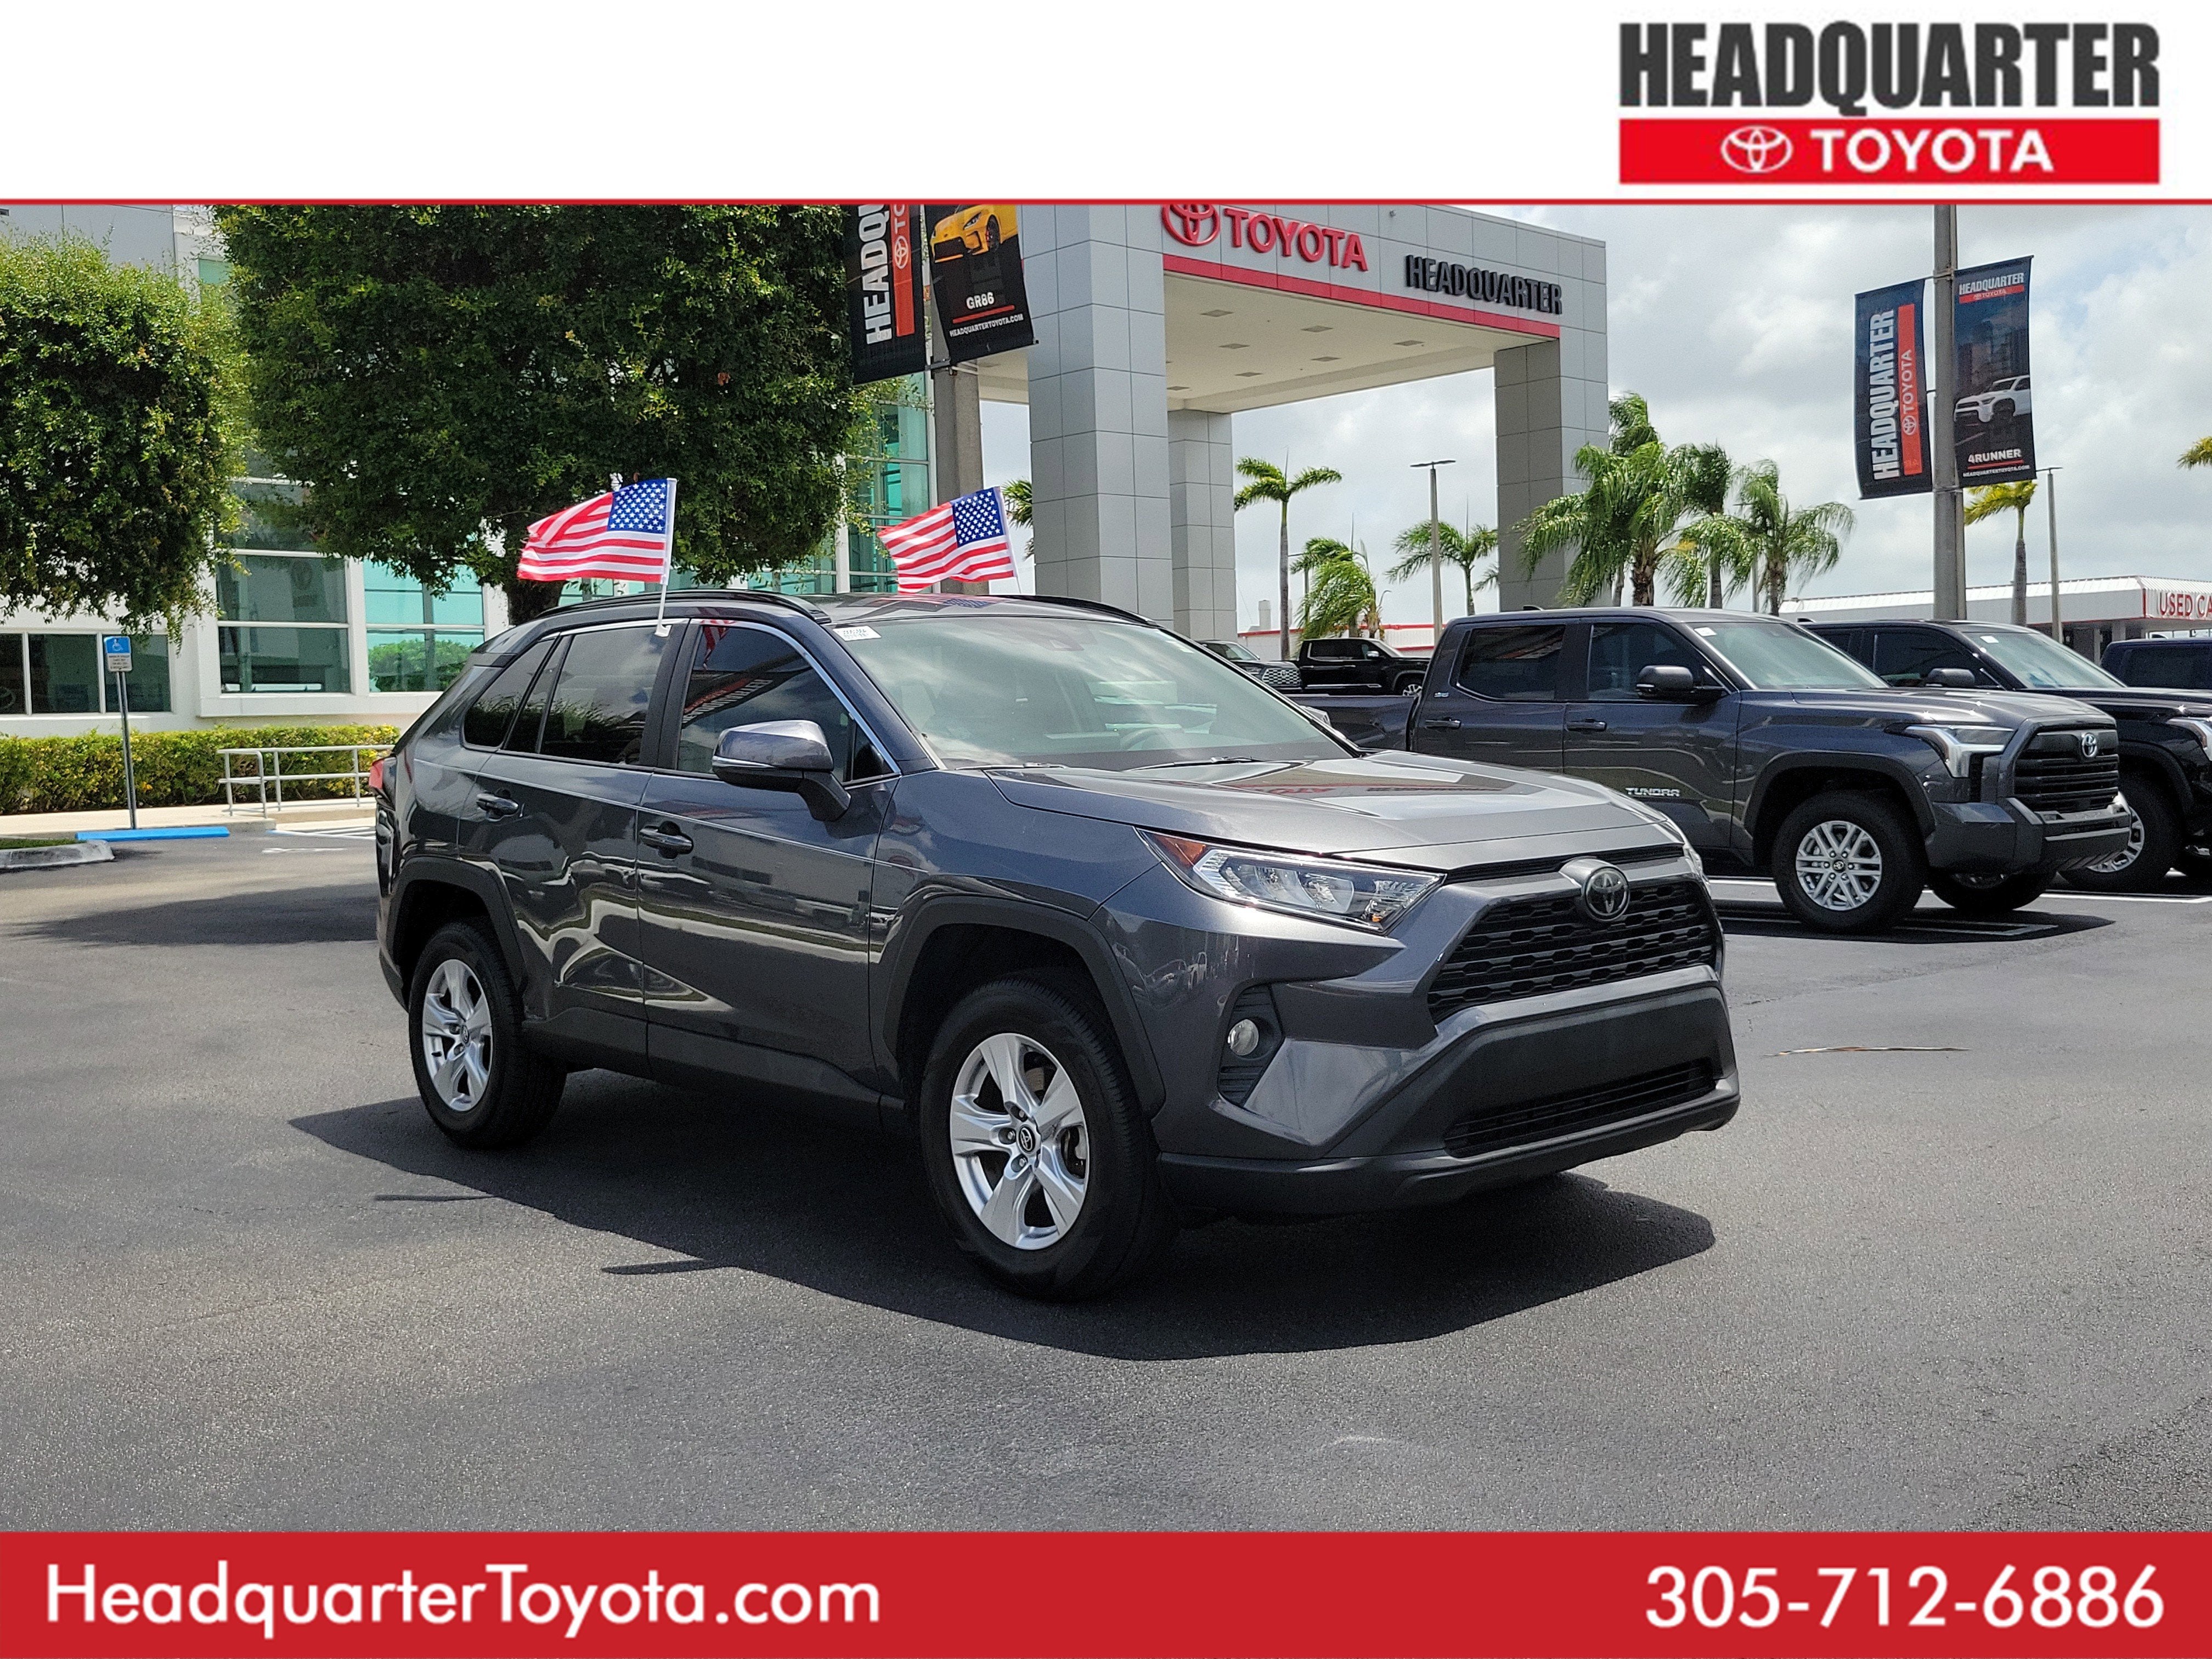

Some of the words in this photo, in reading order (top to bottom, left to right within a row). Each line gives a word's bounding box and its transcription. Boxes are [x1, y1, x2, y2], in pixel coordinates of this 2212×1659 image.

[1223, 207, 1368, 272] TOYOTA
[1406, 255, 1562, 314] HEADQUARTER
[1959, 272, 2024, 295] HEADQUARTER
[966, 292, 995, 309] GR86
[949, 313, 1024, 337] HEADQUARTERTOYOTA.COM
[1901, 348, 1914, 414] TOYOTA
[1870, 310, 1899, 481] HEADQUARTER
[1968, 449, 2022, 464] 4RUNNER
[2159, 593, 2193, 616] USED
[1625, 787, 1680, 797] TUNDRA
